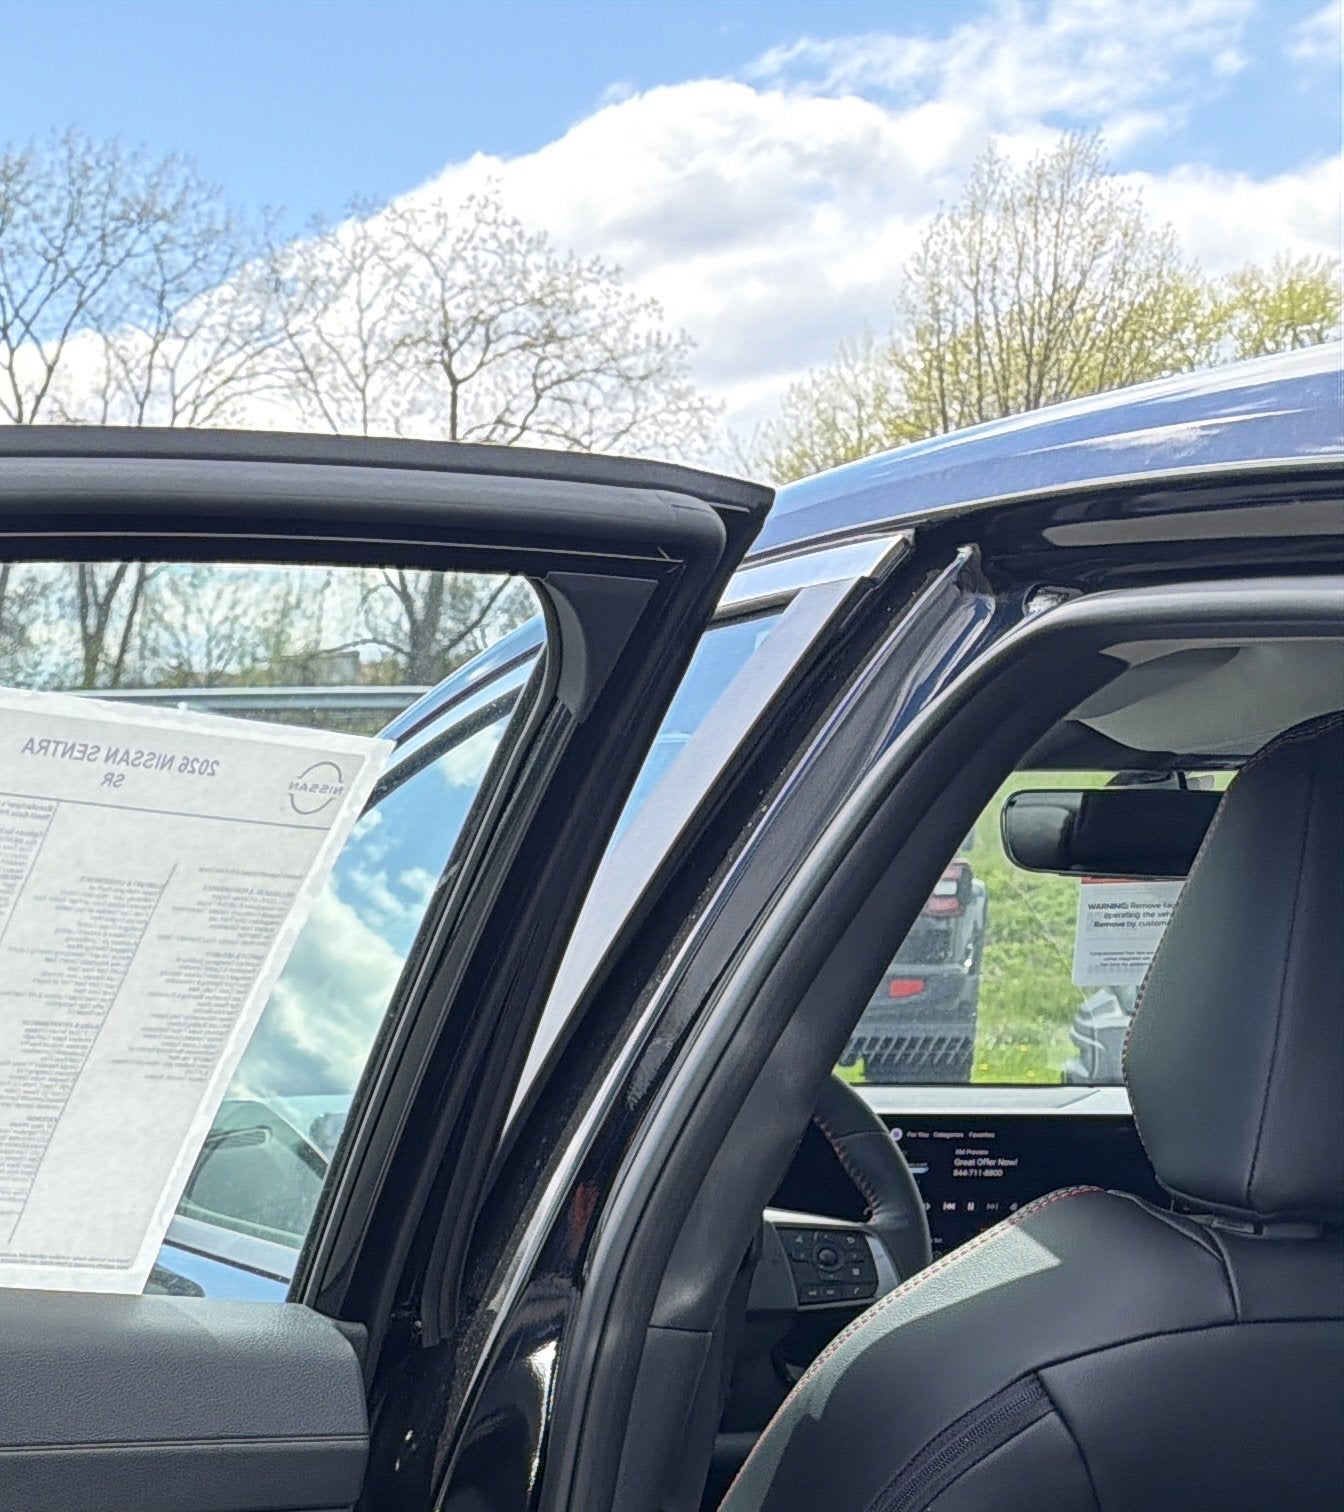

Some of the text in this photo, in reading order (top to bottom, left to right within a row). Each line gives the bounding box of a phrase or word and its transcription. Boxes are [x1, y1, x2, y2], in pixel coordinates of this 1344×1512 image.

[1088, 901, 1160, 910] WARNING: Remove
[1093, 920, 1126, 928] Remove
[1126, 920, 1136, 929] by
[953, 1157, 1019, 1167] Great Offer Now!
